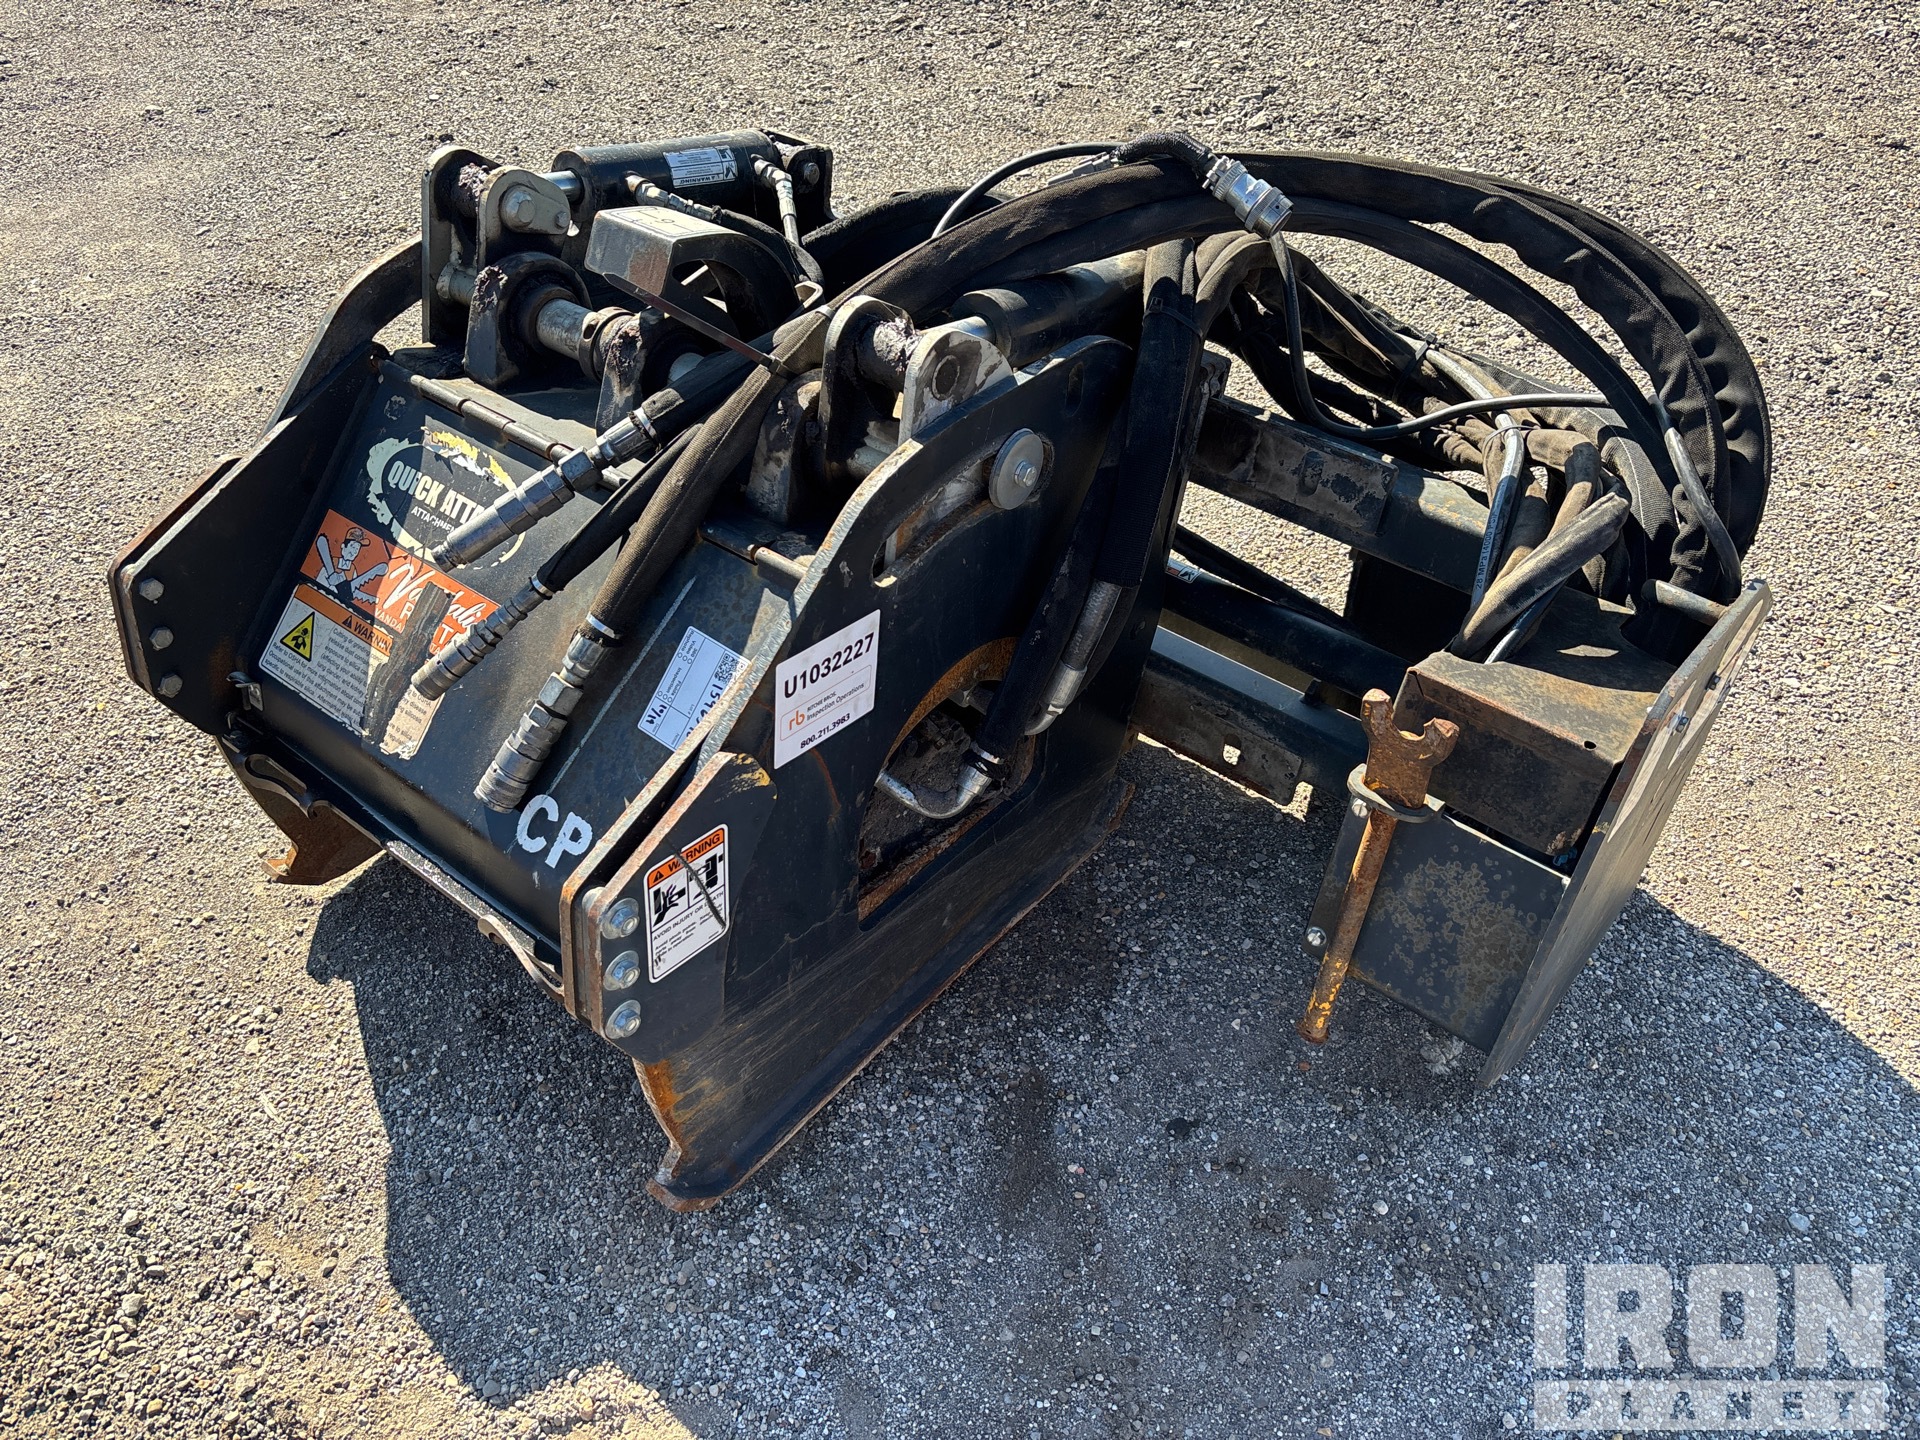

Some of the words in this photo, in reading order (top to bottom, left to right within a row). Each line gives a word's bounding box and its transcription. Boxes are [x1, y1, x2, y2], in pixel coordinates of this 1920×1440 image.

[680, 176, 711, 184] WARNING
[388, 460, 445, 508] QUICK
[440, 489, 485, 525] ATT
[411, 506, 456, 533] ATTACHMEN
[1482, 531, 1493, 554] (4000
[1478, 556, 1488, 577] MPa
[383, 563, 486, 628] Vaali
[1476, 579, 1483, 590] 28
[327, 636, 345, 650] release
[343, 646, 355, 656] dust
[331, 628, 349, 642] Cutting
[352, 641, 370, 656] grinding
[352, 620, 392, 651] WARNIN
[686, 640, 696, 654] Video
[271, 642, 284, 653] Refer
[287, 652, 302, 665] OSHA
[306, 666, 318, 676] more
[316, 672, 342, 692] information
[340, 688, 354, 700] about
[323, 645, 344, 661] exposure
[348, 660, 361, 671] silica
[784, 632, 874, 699] U1032227
[263, 658, 280, 672] specific
[282, 671, 305, 688] respirable
[316, 693, 342, 713] Aftermarket
[267, 649, 295, 671] Occupational
[292, 667, 302, 676] use
[305, 675, 315, 684] this
[313, 681, 338, 700] attachment
[336, 697, 347, 707] may
[346, 702, 354, 710] be
[315, 661, 326, 672] lung
[341, 677, 351, 686] and
[348, 683, 365, 697] kidney
[339, 666, 350, 676] your
[348, 671, 363, 684] ability
[666, 667, 682, 694] Inspection
[671, 681, 682, 696] Fluids
[408, 700, 427, 716] disease
[807, 699, 835, 721] Inspection
[836, 682, 865, 705] Operations
[807, 698, 823, 712] RITCHIE
[788, 709, 805, 731] rb
[800, 713, 850, 749] 800.211.3983
[517, 794, 593, 869] CP
[653, 926, 672, 941] AVOID
[672, 911, 694, 929] INJURY
[694, 904, 706, 914] OR
[705, 891, 724, 907] DATH
[655, 939, 668, 951] Avoid
